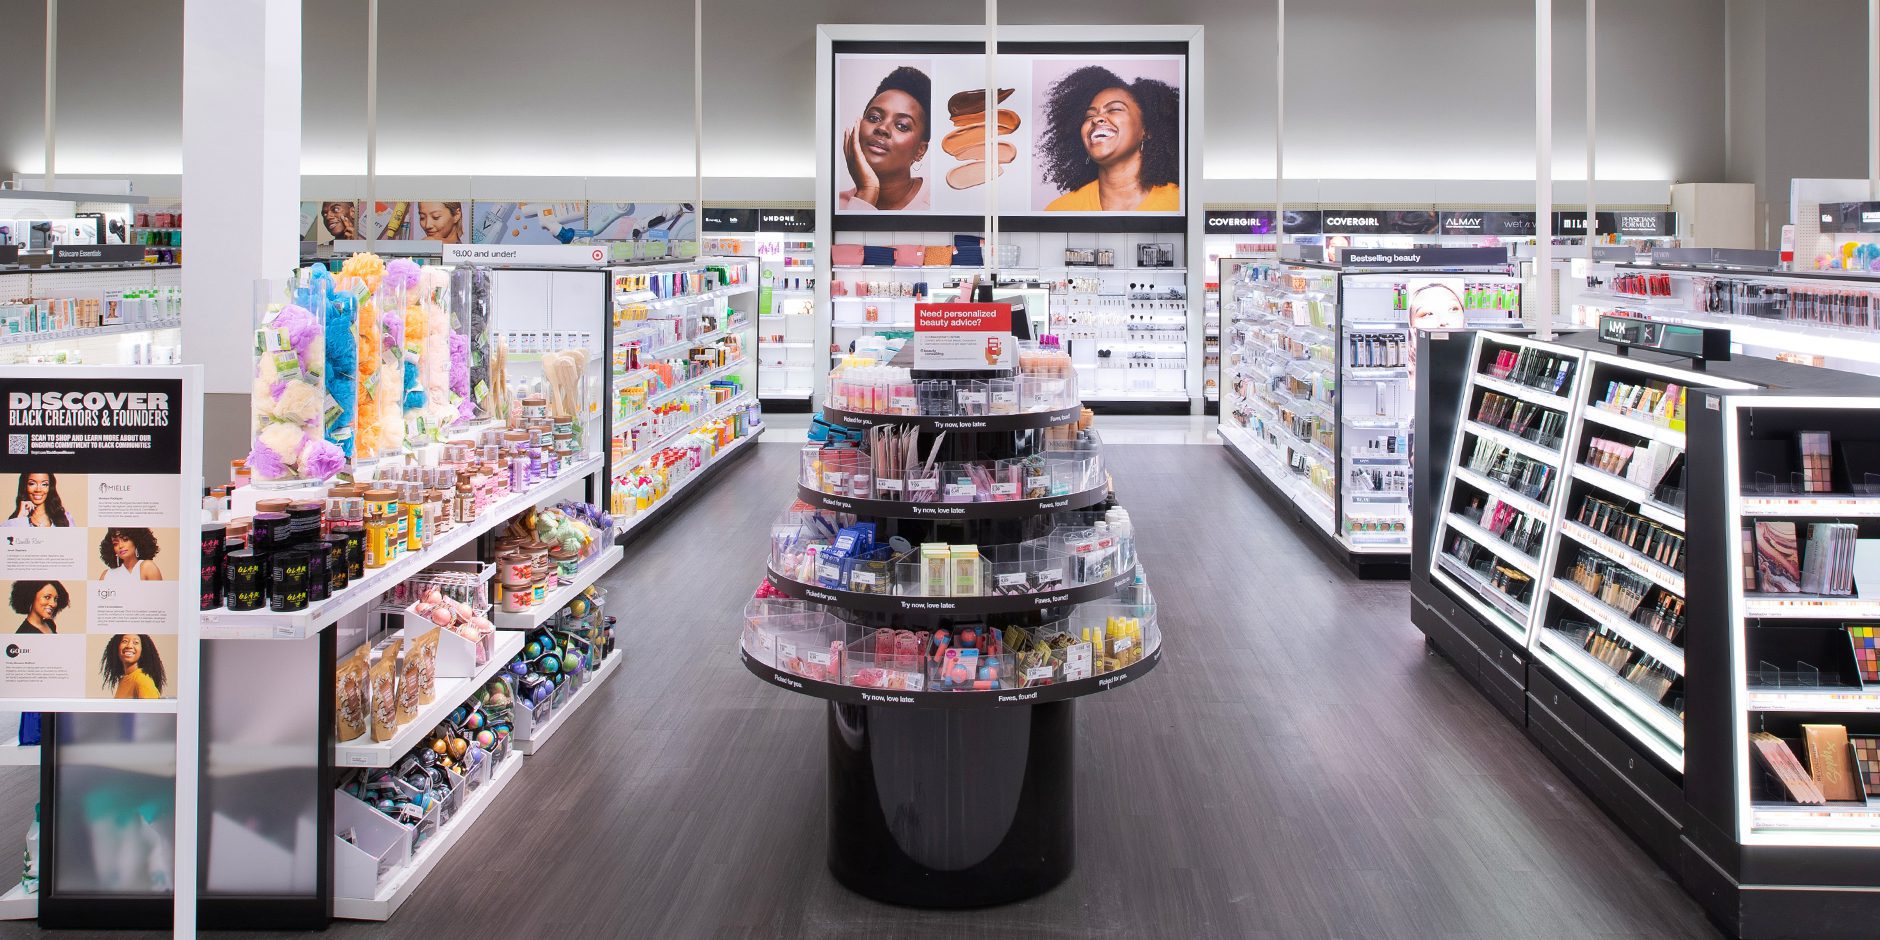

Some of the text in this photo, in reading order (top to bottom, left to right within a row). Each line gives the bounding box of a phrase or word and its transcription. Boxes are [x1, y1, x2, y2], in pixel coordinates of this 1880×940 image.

[1209, 218, 1262, 226] COVERGIRL
[1327, 217, 1379, 226] COVERGIRL
[1504, 220, 1523, 228] wet
[1563, 219, 1599, 229] MILAI
[58, 250, 79, 258] Skincare
[452, 249, 517, 258] $8.00 and under!
[1350, 254, 1421, 263] Bestselling beauty
[919, 310, 997, 319] Need personalized
[919, 318, 982, 328] beauty advice?
[1609, 320, 1626, 334] NYX
[9, 392, 169, 410] DISCOVER
[9, 409, 169, 427] BLACK CREATORS & FOUNDERS
[934, 421, 943, 429] Try
[31, 434, 151, 442] SCAN TO SHOP AND LEARN MORE ABOUT OUR
[31, 441, 151, 449] ONGOING COMMITMENT TO BLACK COMMUNITIES
[108, 484, 131, 492] MIELLE
[912, 506, 922, 514] Try
[1039, 502, 1055, 510] Faves,
[97, 588, 117, 600] tgin
[1034, 593, 1069, 605] Faves, found!
[901, 601, 912, 609] Try
[861, 692, 871, 701] Try
[886, 694, 899, 702] love
[899, 695, 915, 703] later.
[998, 691, 1038, 702] Faves, found!
